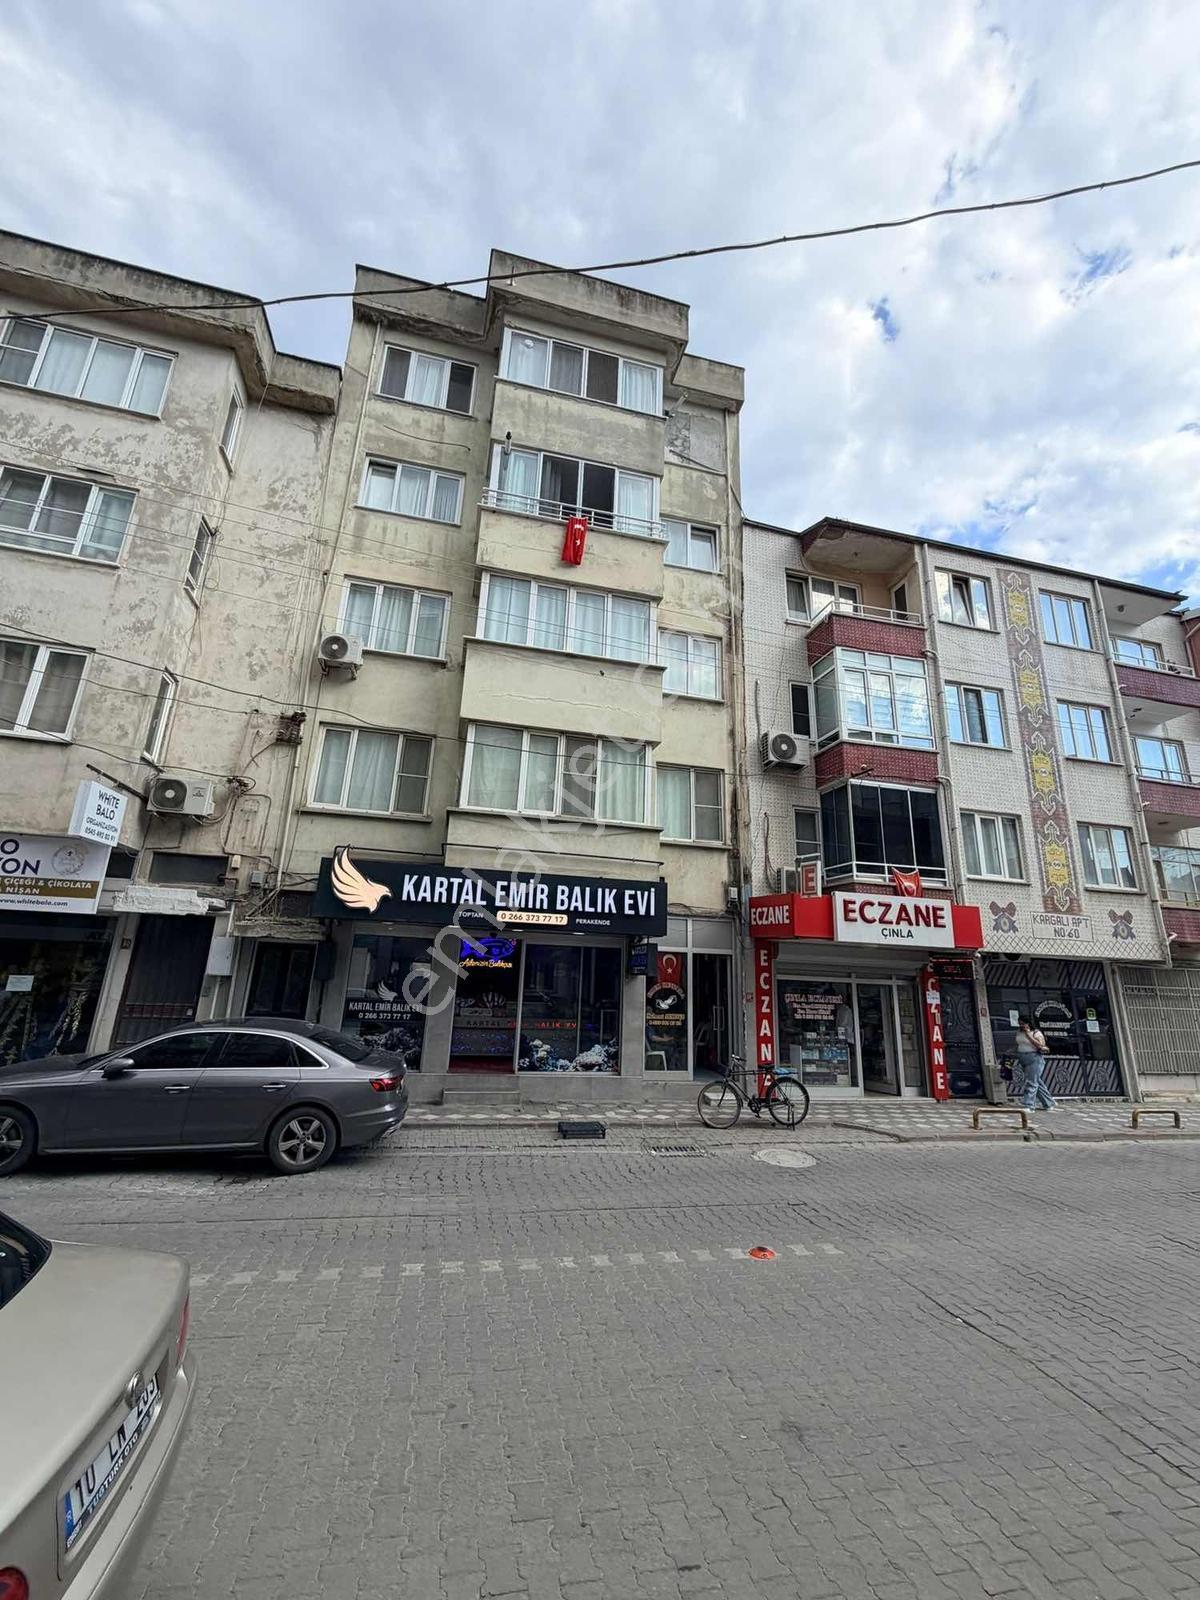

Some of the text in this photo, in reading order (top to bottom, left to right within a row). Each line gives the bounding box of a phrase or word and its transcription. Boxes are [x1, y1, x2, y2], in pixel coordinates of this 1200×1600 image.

[96, 804, 116, 820] BALO
[0, 857, 41, 875] ON
[47, 879, 92, 890] ÇİKOLATA
[806, 870, 816, 893] E
[402, 874, 655, 917] KARTAL EMİR BALIK EVİ
[458, 911, 485, 919] TOPTAN
[508, 913, 523, 921] 266
[526, 914, 541, 922] 373
[575, 918, 611, 926] PERAKENDE
[751, 905, 790, 925] ECZANE
[842, 899, 947, 929] ECZANE
[1033, 915, 1089, 928] KARGALI APT
[881, 928, 914, 940] ÇINLA
[348, 1001, 373, 1011] KARTAL
[374, 1001, 391, 1012] EMİR
[364, 1012, 378, 1020] 266
[124, 1433, 138, 1457] OTO
